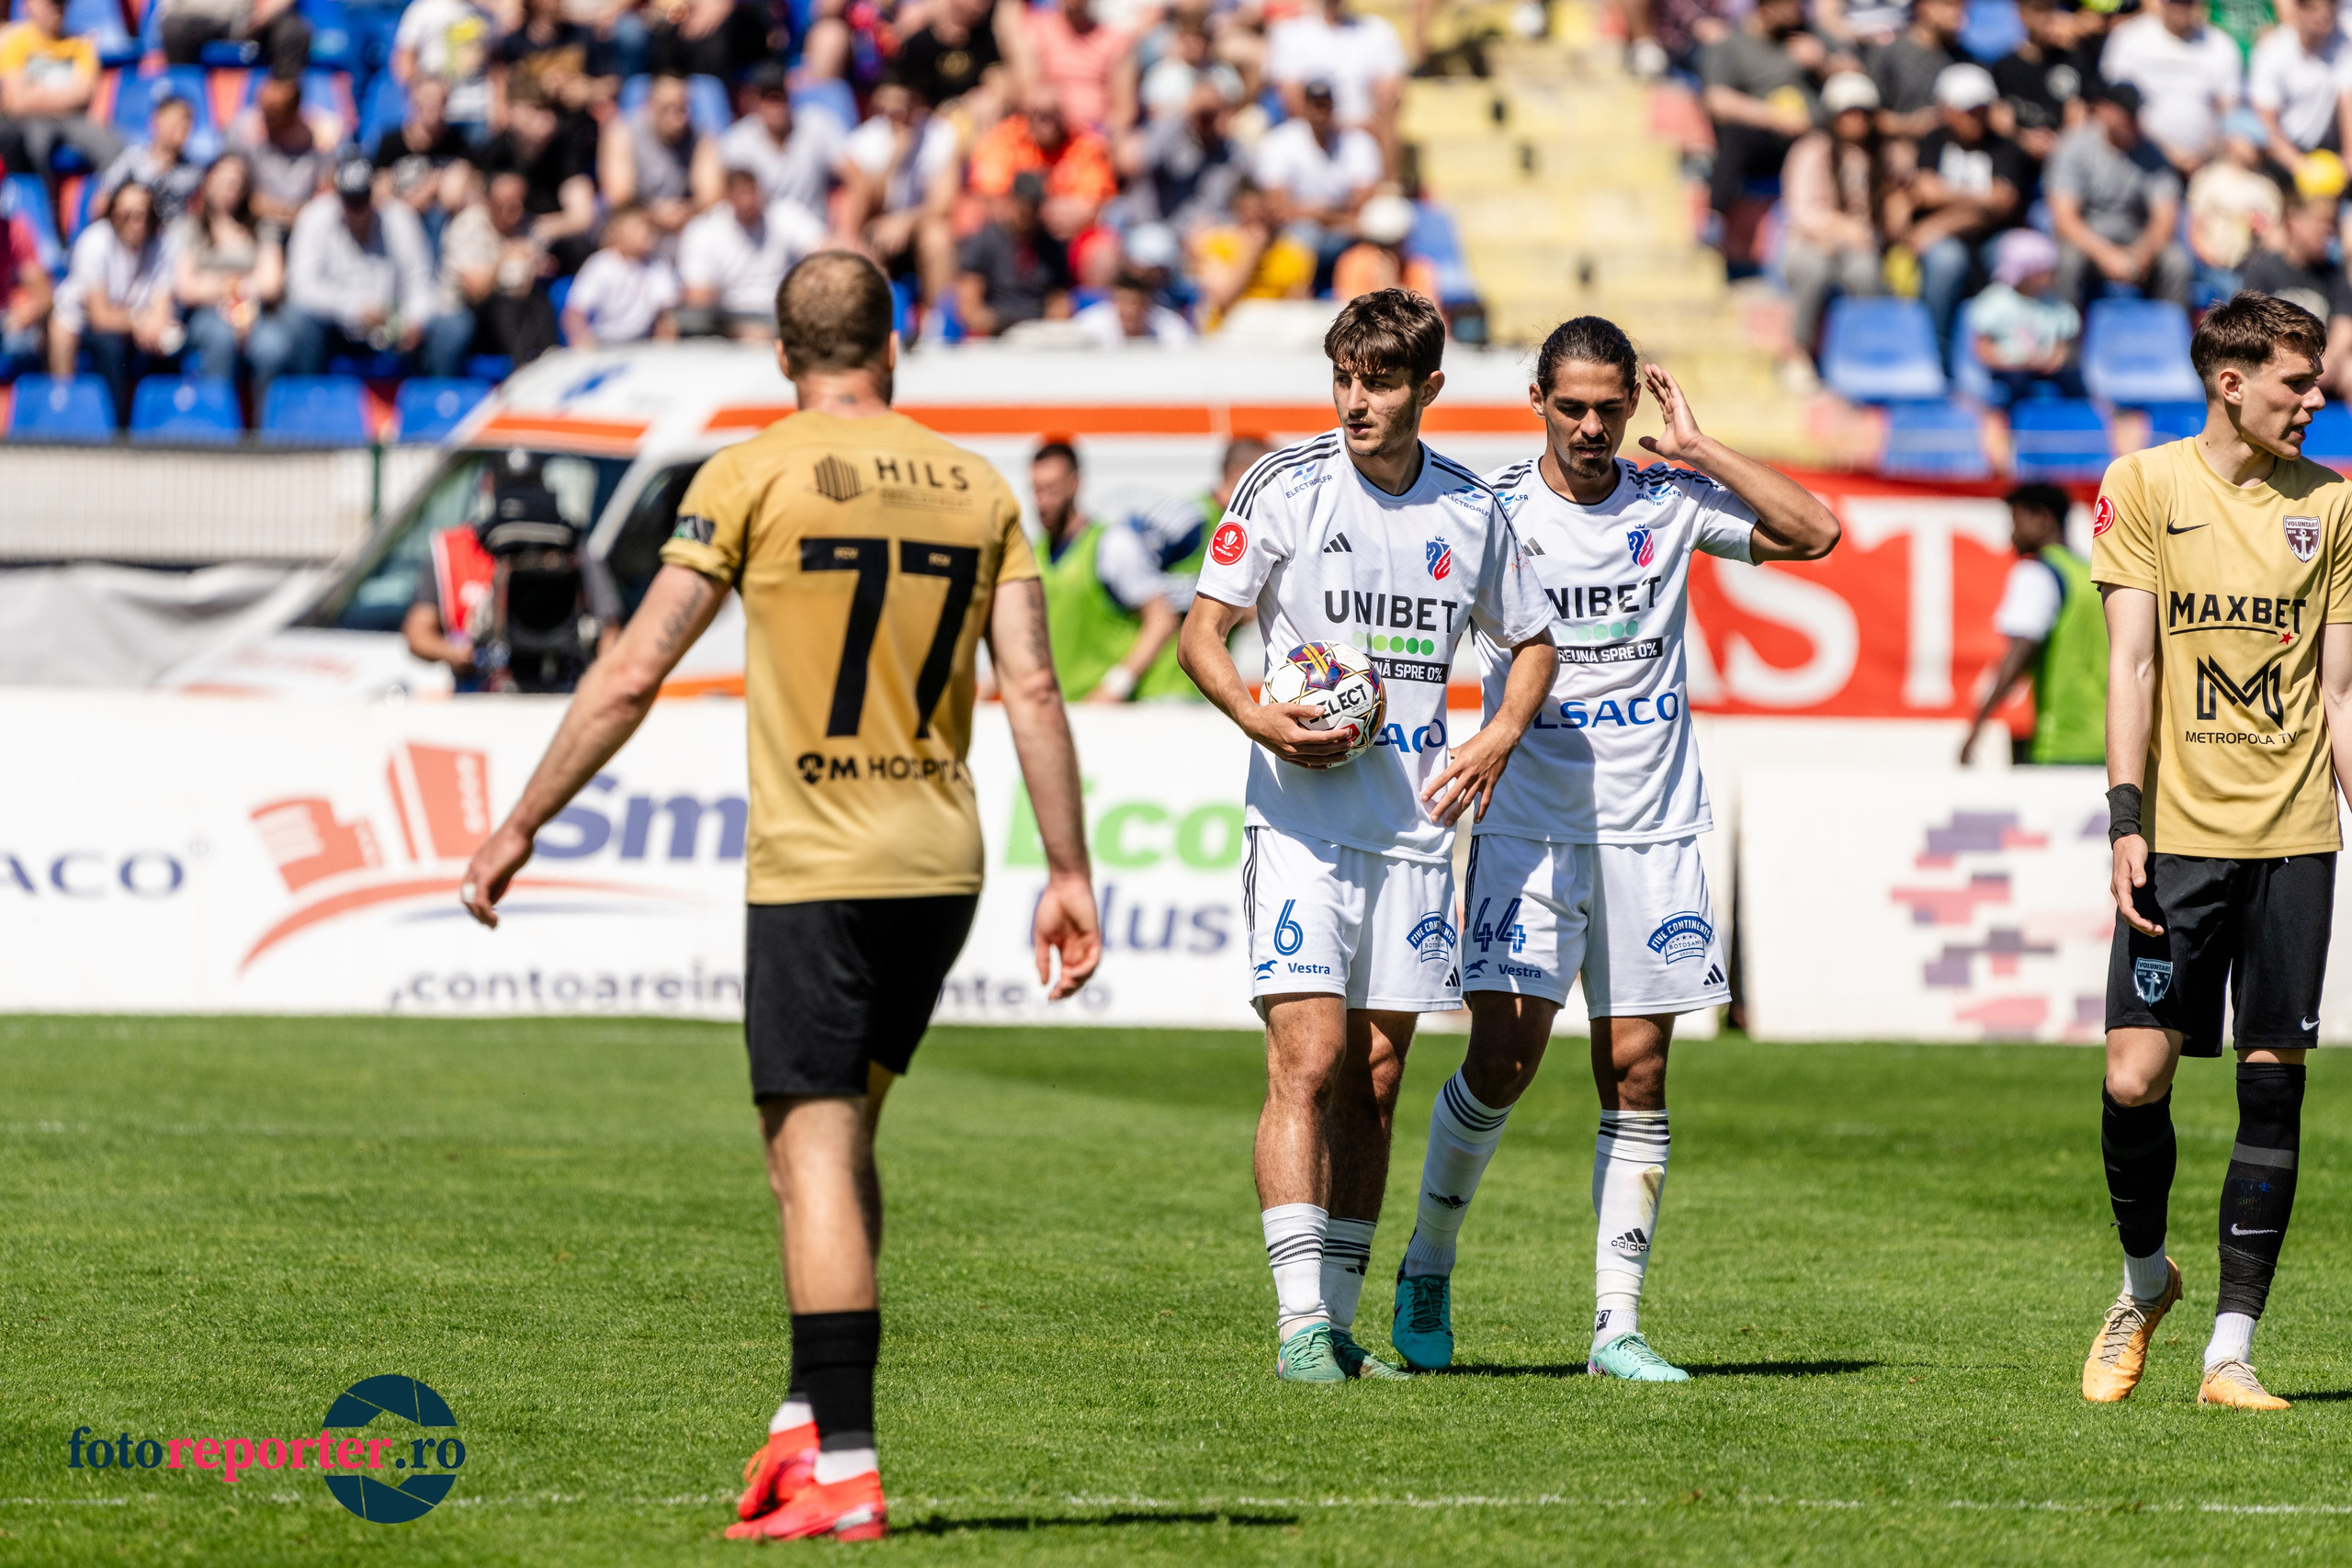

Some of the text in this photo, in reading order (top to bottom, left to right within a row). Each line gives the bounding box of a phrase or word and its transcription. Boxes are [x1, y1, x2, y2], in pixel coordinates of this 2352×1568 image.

[875, 457, 969, 492] HILS
[1324, 590, 1458, 634] UNIBET
[1544, 576, 1662, 619] NIBET
[2169, 591, 2306, 635] MAXBET
[800, 537, 980, 739] 77
[1601, 648, 1635, 662] SPRE
[1638, 642, 1657, 658] 0%
[1395, 663, 1424, 680] SPRE
[1427, 668, 1442, 682] 0%
[1532, 693, 1679, 729] LSACO
[2186, 730, 2297, 745] METROPOLA TV
[1273, 898, 1304, 956] 6
[1410, 926, 1425, 944] FIVE
[1473, 897, 1527, 953] 44
[1651, 919, 1711, 949] FIVE CONTINENTS
[1668, 940, 1702, 951] BOTOSANI
[1287, 962, 1330, 975] Vestra
[1498, 964, 1542, 979] Vestra
[1611, 1239, 1650, 1252] adidas
